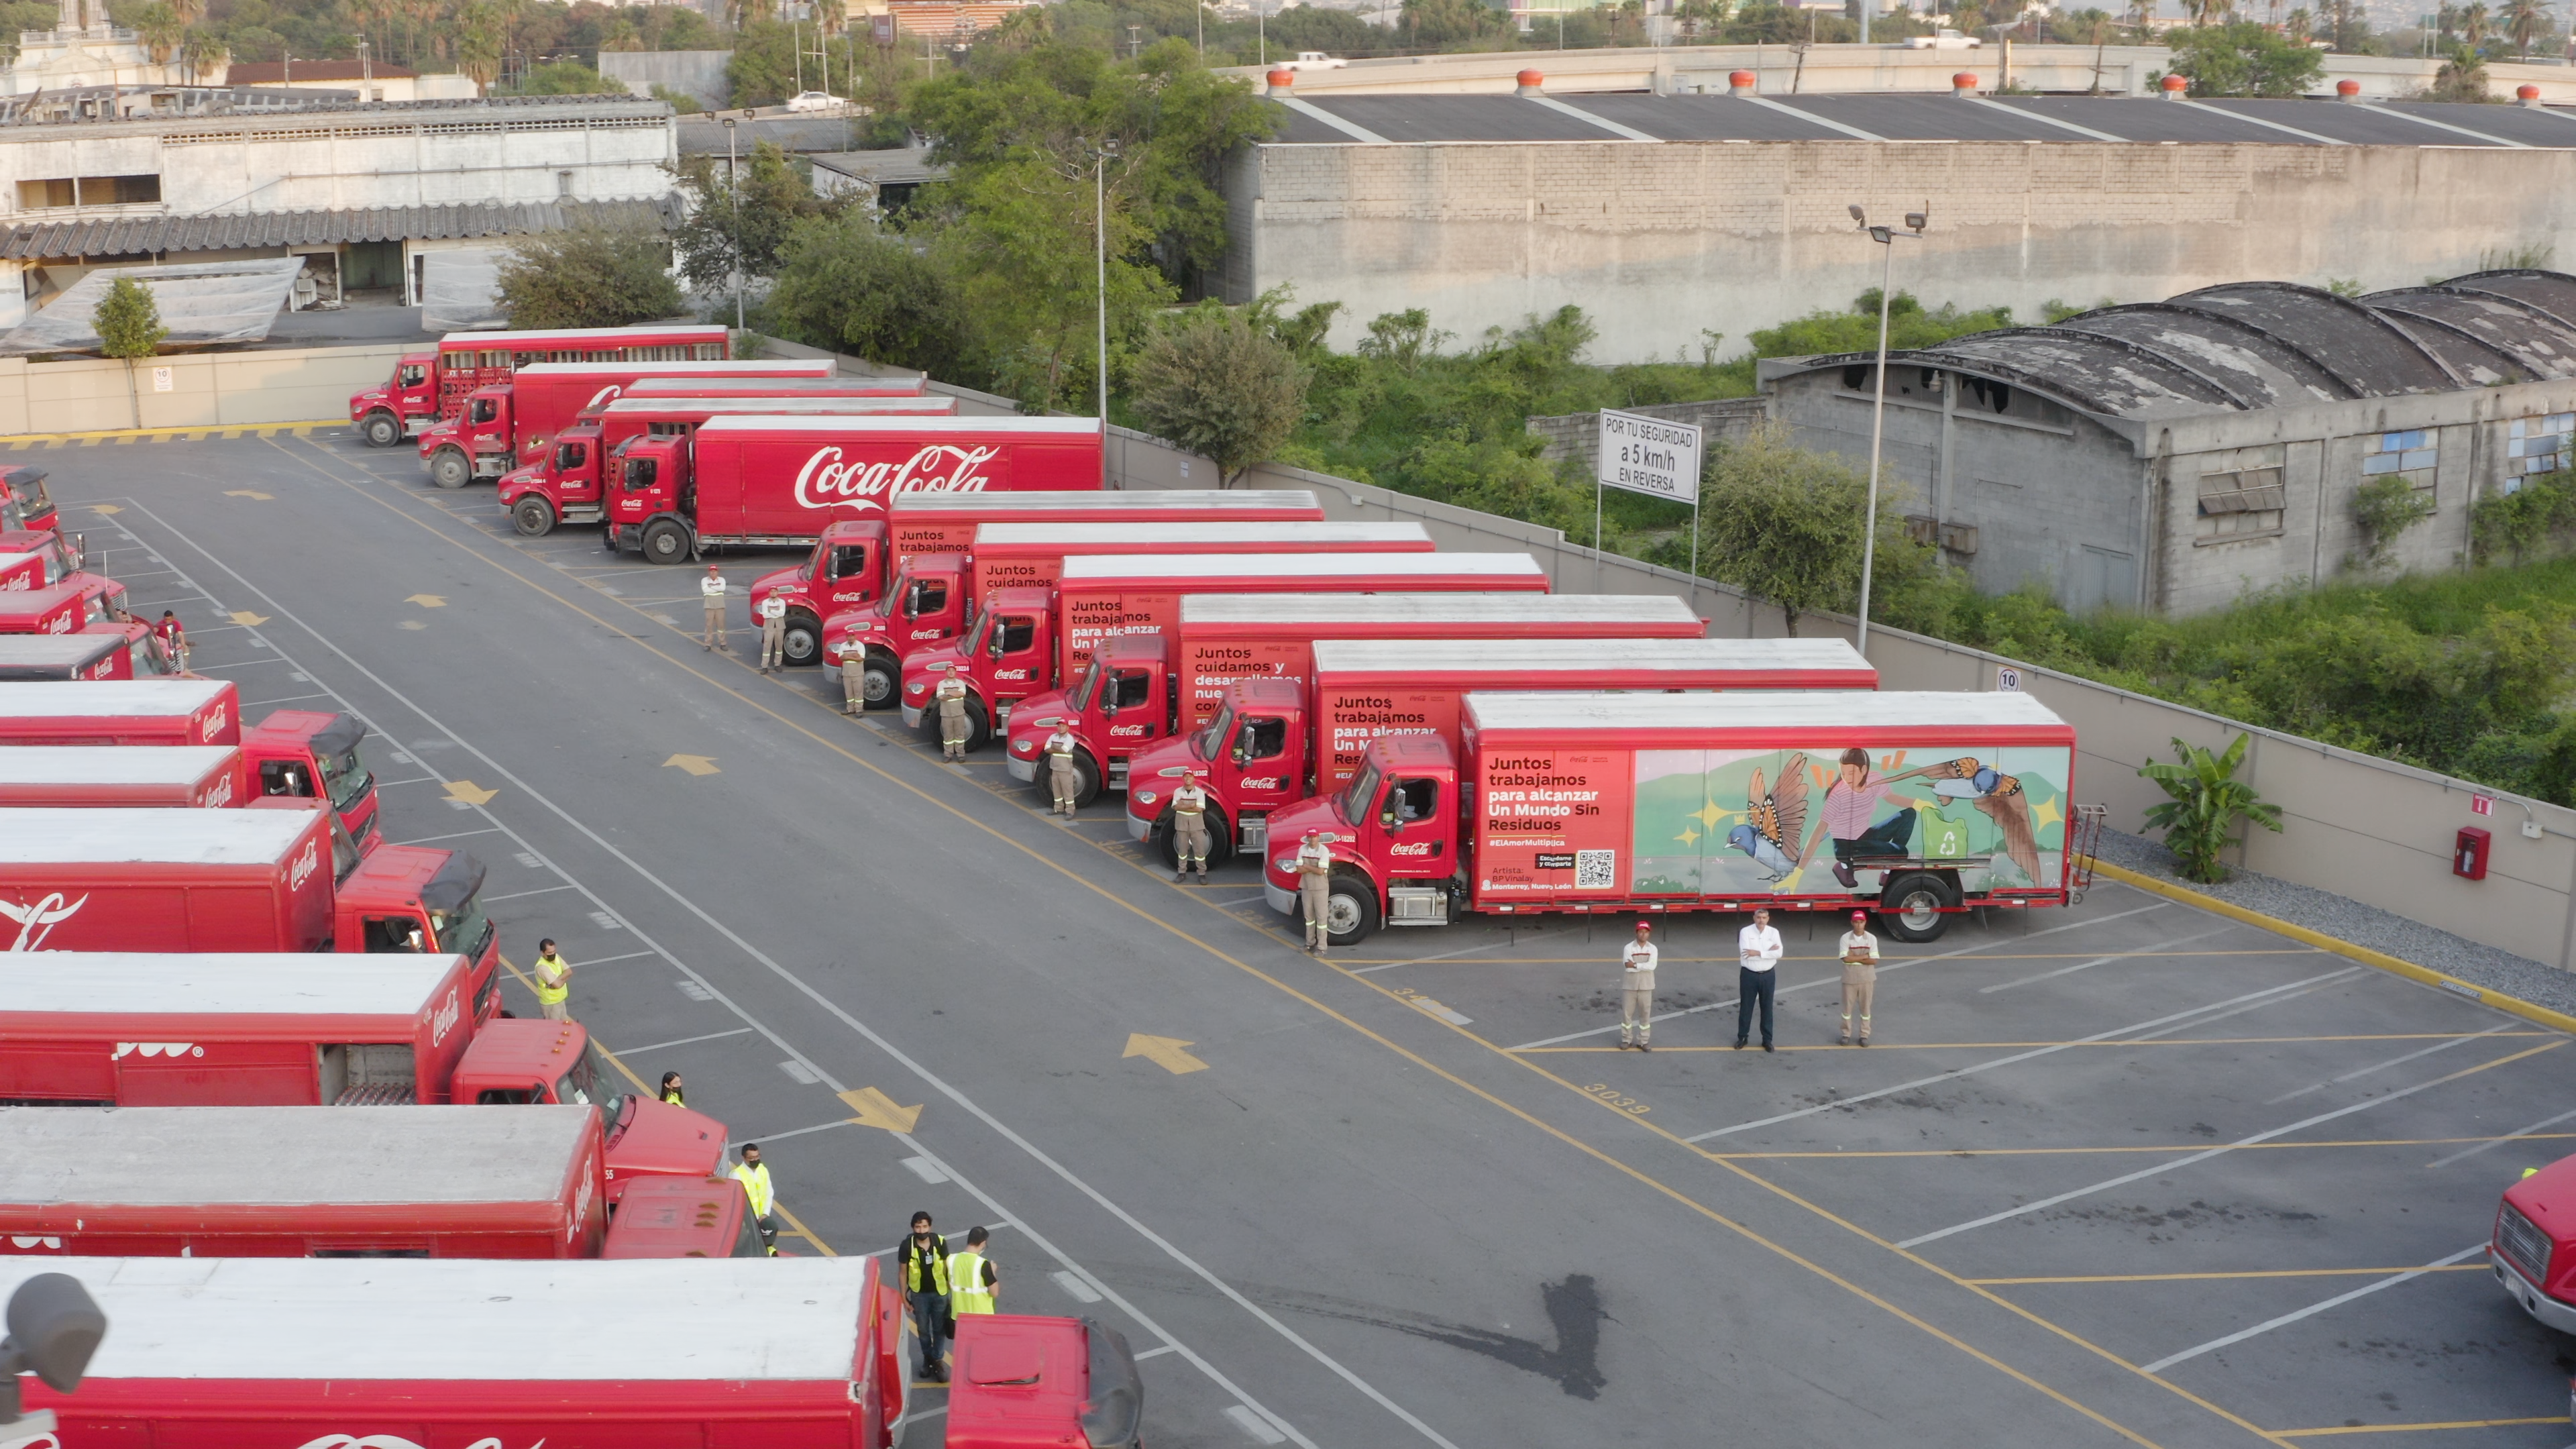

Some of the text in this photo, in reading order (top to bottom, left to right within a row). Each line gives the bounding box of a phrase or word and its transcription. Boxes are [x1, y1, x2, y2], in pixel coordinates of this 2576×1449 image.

[1606, 418, 1693, 447] POR TU SEGURIDAD
[1621, 443, 1674, 472] a 5 km/h
[1619, 468, 1674, 492] EN REVERSA
[900, 531, 944, 540] Juntos
[900, 543, 969, 553] trabajamos
[987, 566, 1036, 575] Juntos
[987, 578, 1053, 588] cuidamos
[1071, 601, 1122, 611] Juntos
[1072, 612, 1150, 626] trabajamos
[1072, 625, 1161, 639] para alcanzar
[1072, 639, 1089, 649] Un
[1195, 647, 1251, 658] Juntos
[1195, 661, 1285, 674] cuidamos y
[2002, 674, 2015, 687] 10
[1334, 696, 1392, 708] Juntos
[1334, 711, 1425, 724] trabajamos
[1334, 727, 1368, 739] para
[1334, 740, 1354, 751] Un
[1489, 757, 1552, 769] Juntos
[1489, 773, 1587, 788] trabajamos
[1489, 788, 1598, 804] para alcanzar
[1489, 804, 1599, 816] Un Mundo Sin
[1489, 818, 1561, 830] Residuos
[1584, 1083, 1651, 1114] 3039
